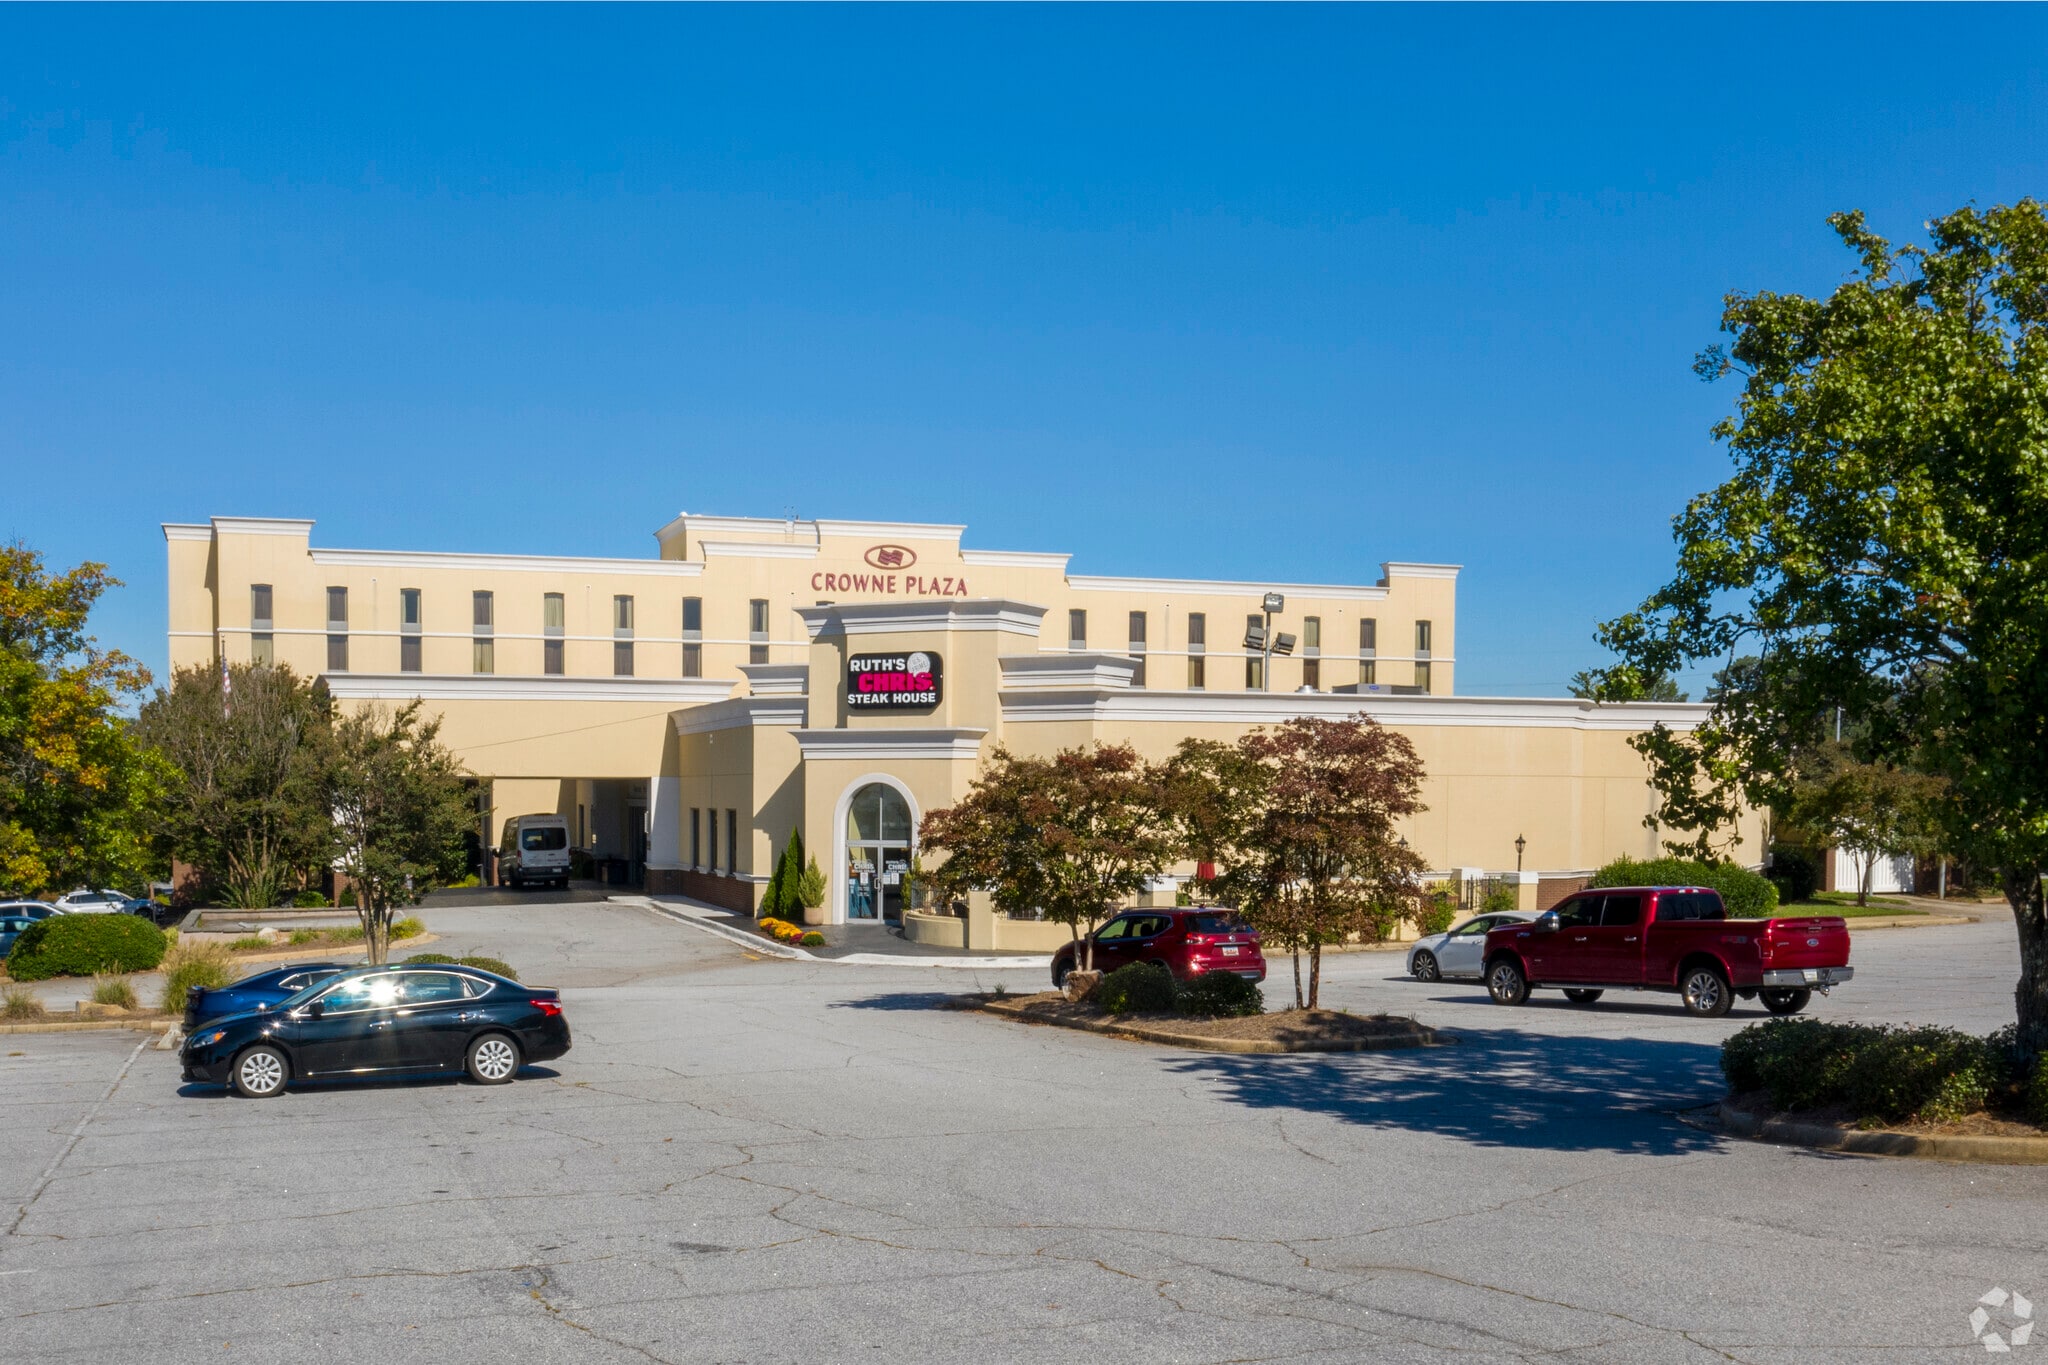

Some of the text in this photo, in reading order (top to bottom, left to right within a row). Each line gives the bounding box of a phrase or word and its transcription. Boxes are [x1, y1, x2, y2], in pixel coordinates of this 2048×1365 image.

[811, 572, 968, 596] CROWNE PLAZA
[850, 658, 906, 672] RUTH'S
[847, 692, 936, 704] STEAK HOUSE
